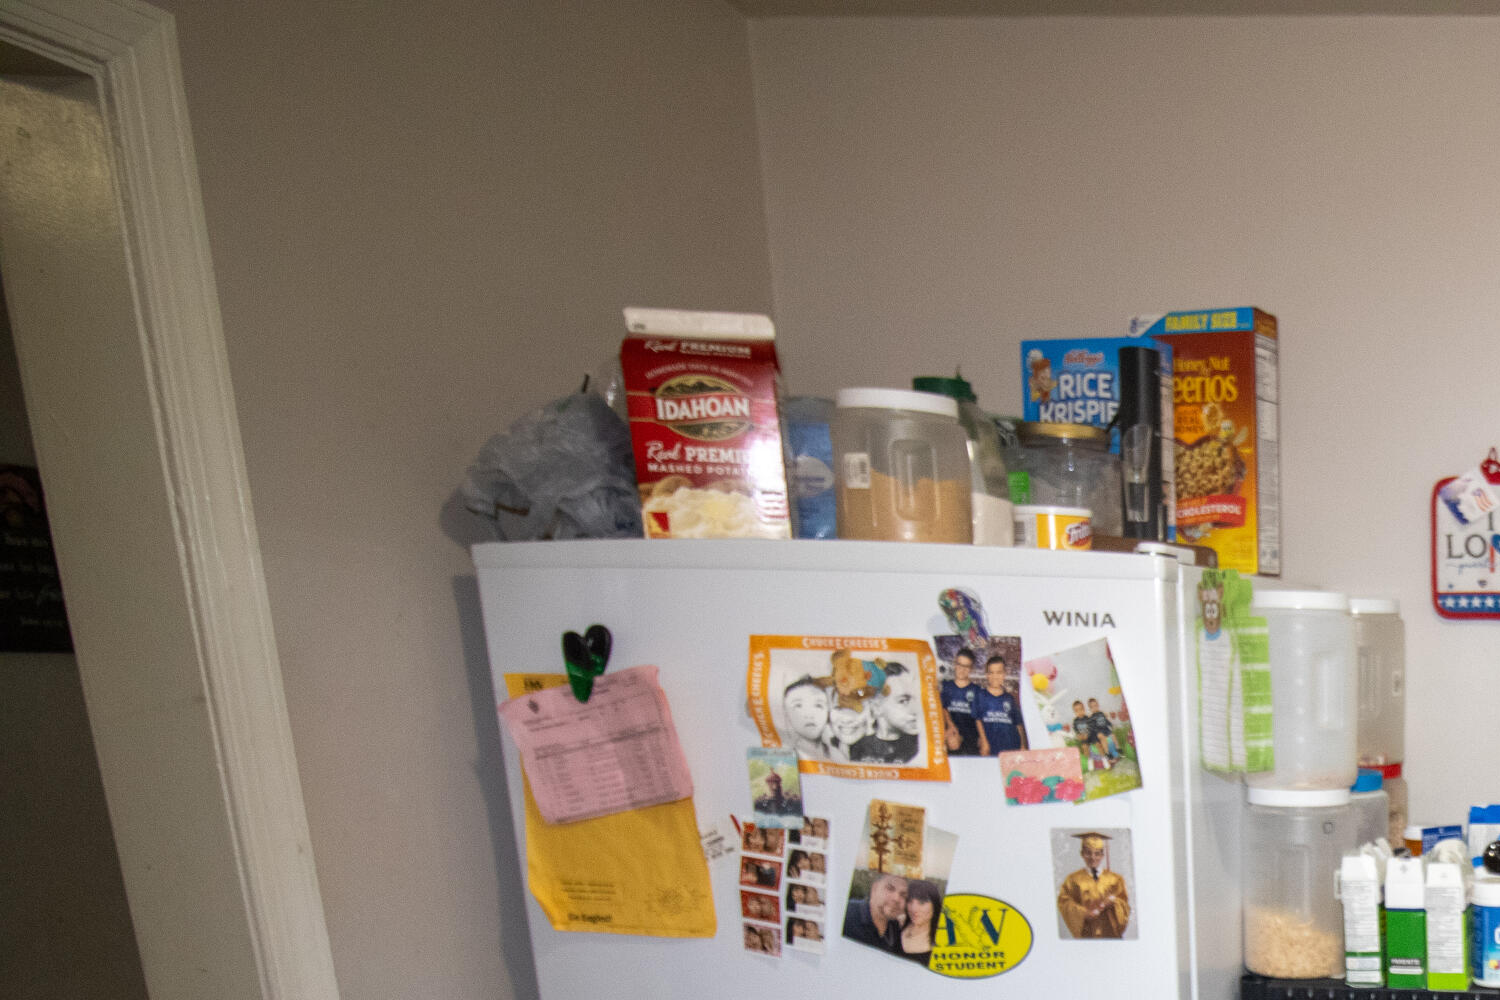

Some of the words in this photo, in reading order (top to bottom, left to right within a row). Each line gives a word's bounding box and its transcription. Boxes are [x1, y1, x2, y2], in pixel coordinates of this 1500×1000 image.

[1059, 372, 1113, 400] RICE
[655, 397, 750, 421] IDAHOAN
[647, 463, 703, 475] MASHED
[1043, 610, 1117, 629] WINIA
[934, 951, 1006, 961] HONOR
[935, 961, 1006, 971] STUDENT
